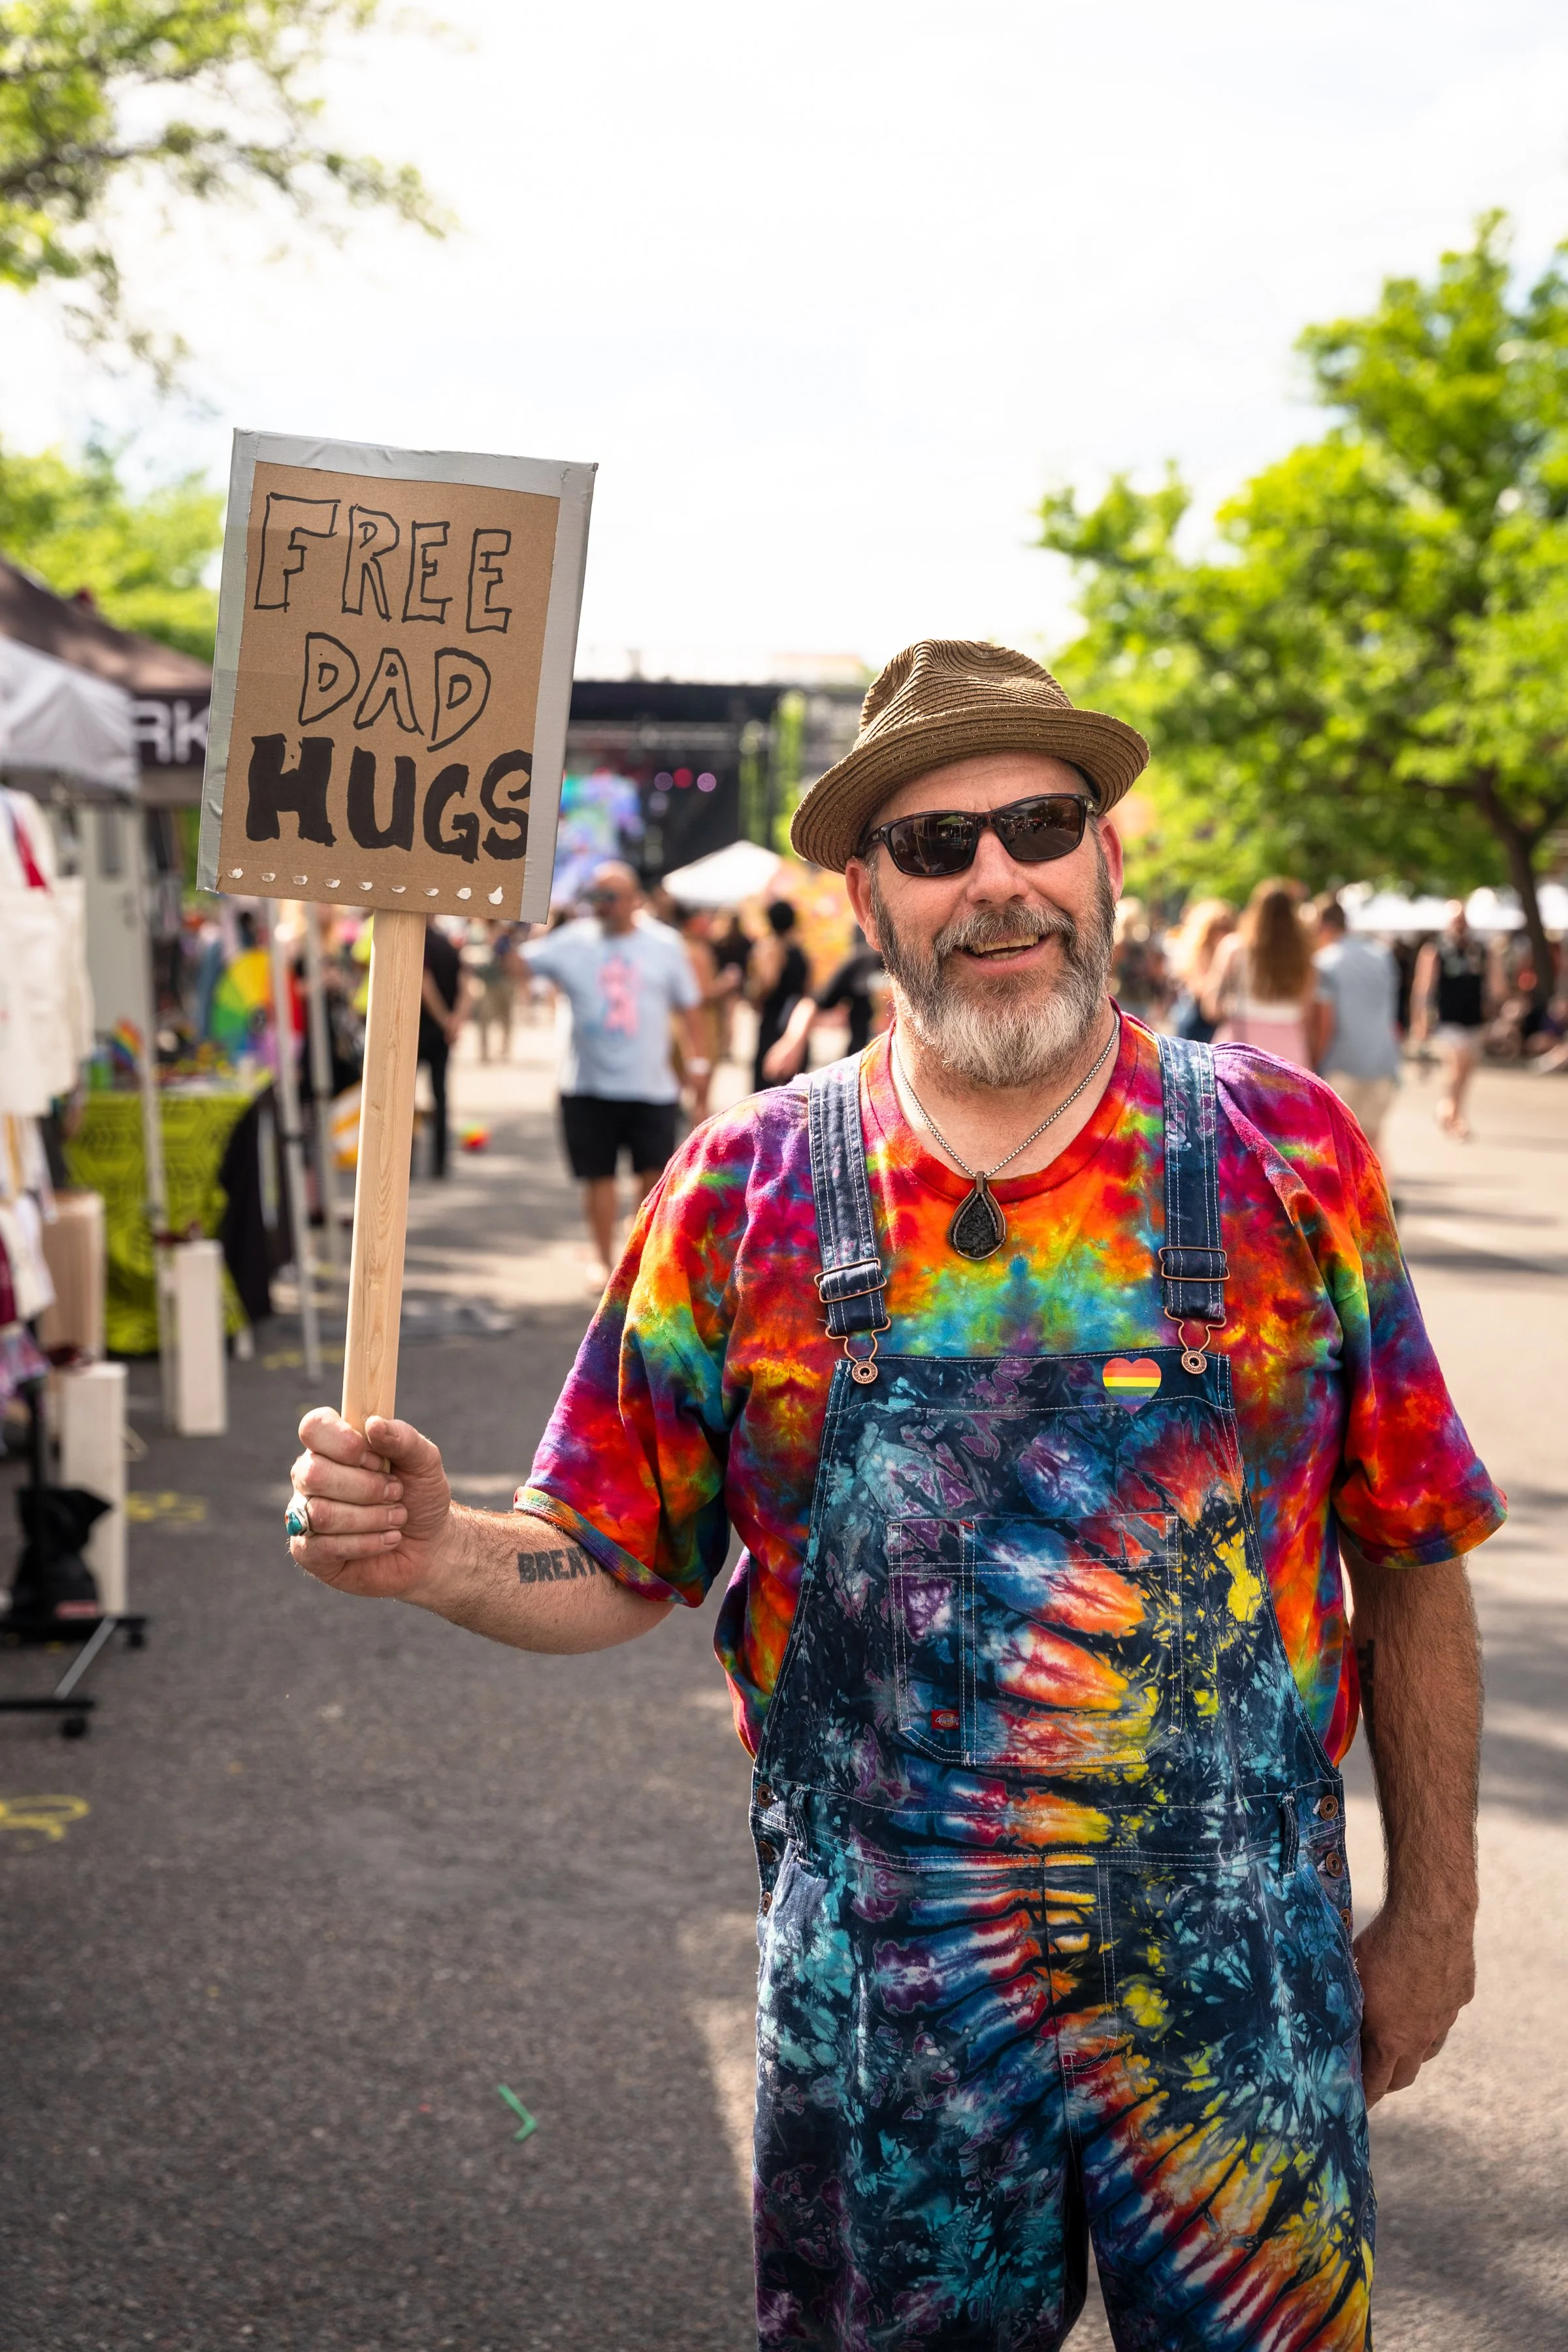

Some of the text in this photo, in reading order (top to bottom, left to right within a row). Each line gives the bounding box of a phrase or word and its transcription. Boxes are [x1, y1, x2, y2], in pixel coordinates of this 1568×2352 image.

[254, 491, 513, 634] FREE
[297, 631, 491, 753] DAD
[246, 732, 533, 864] HUGS
